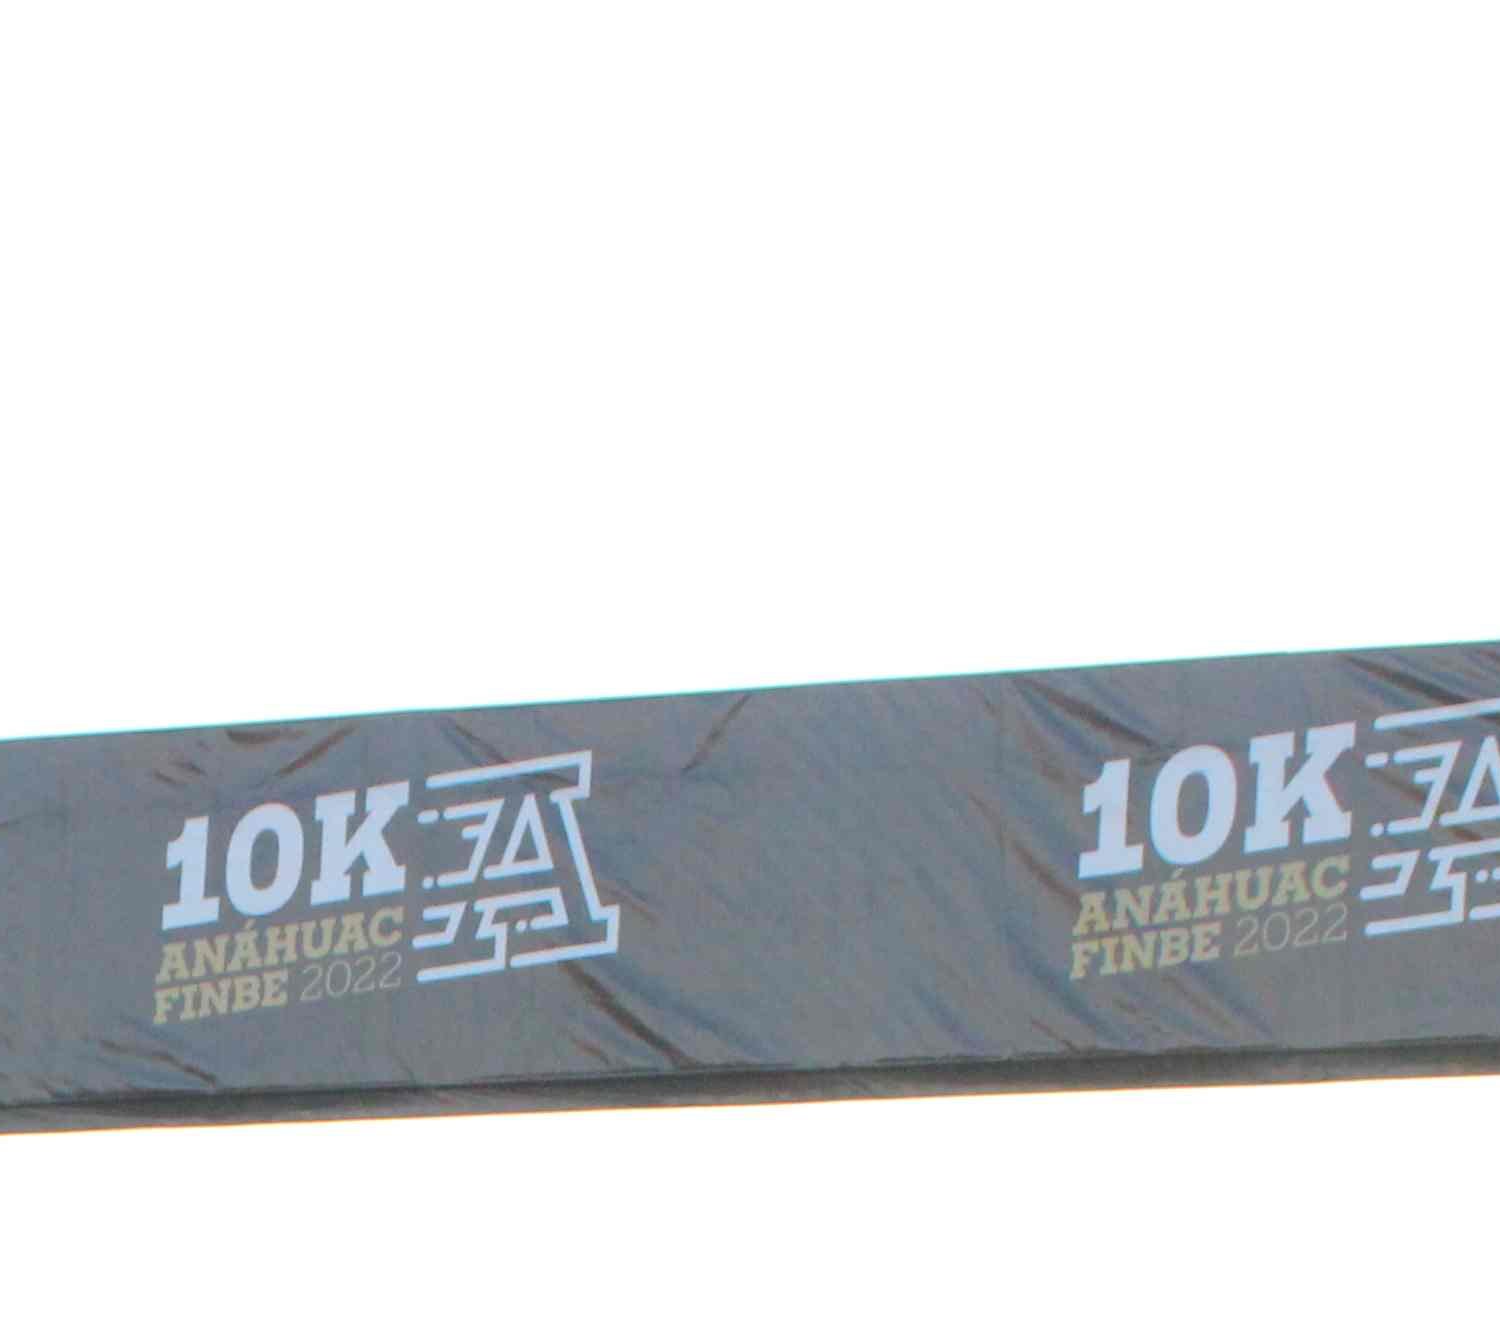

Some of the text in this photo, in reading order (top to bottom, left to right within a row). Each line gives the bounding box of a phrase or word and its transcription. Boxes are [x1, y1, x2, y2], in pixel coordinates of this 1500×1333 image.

[1077, 721, 1358, 880] 10K
[162, 781, 410, 931] 10K
[1071, 855, 1352, 937] ANÁHUAC
[155, 907, 405, 985] ANÁHUAC
[1069, 903, 1349, 981] FINBE 2022
[152, 951, 402, 1025] FINBE 2022
